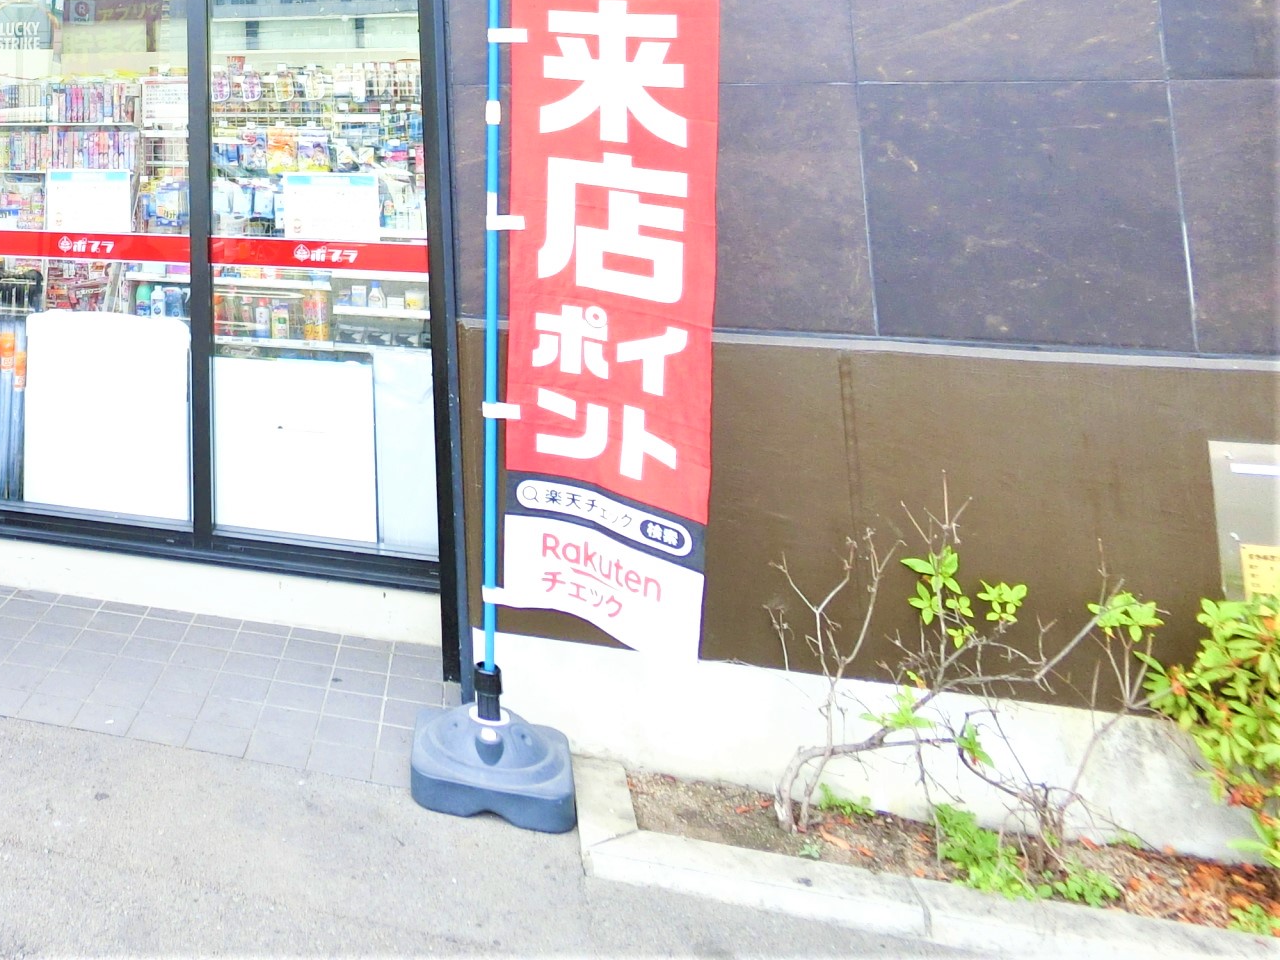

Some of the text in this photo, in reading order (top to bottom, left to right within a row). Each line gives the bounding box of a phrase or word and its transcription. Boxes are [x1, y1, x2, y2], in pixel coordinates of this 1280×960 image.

[0, 21, 40, 36] LUCKY
[537, 0, 689, 304] 来店
[73, 237, 114, 254] ポプラ
[310, 246, 359, 263] ポプラ
[545, 489, 633, 528] 楽天チェック
[541, 532, 662, 603] Rakuten
[541, 571, 624, 618] チェック
